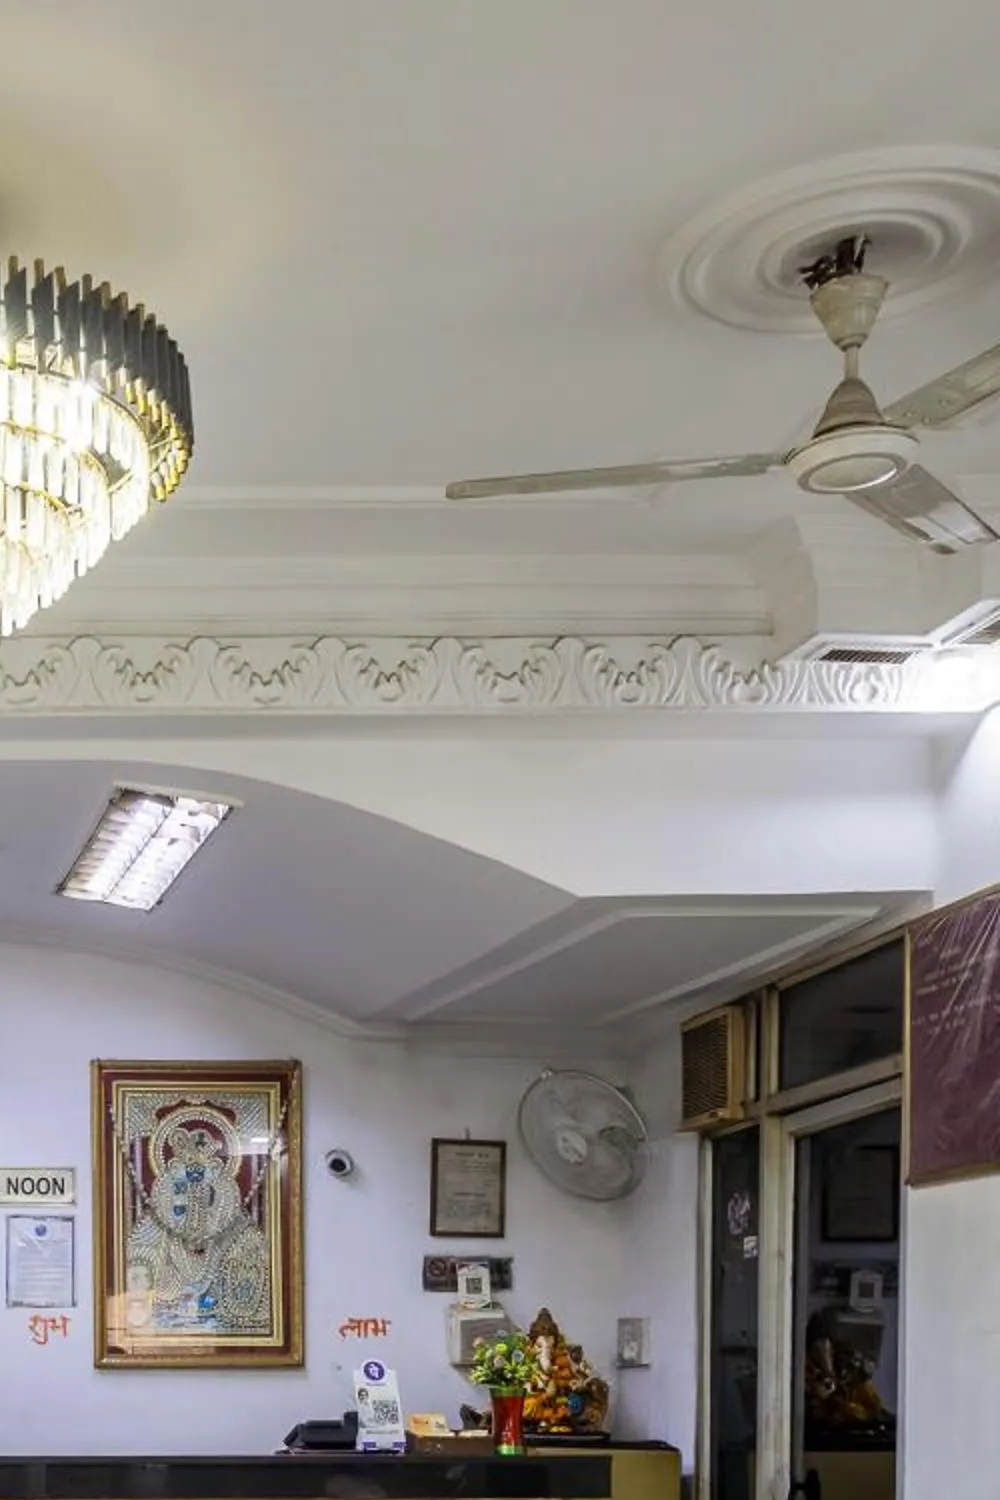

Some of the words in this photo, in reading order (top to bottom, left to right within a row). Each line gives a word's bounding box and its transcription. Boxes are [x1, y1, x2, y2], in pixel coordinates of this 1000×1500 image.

[6, 1175, 66, 1195] NOON
[28, 1314, 73, 1345] शुभ
[338, 1317, 392, 1342] लाभ
